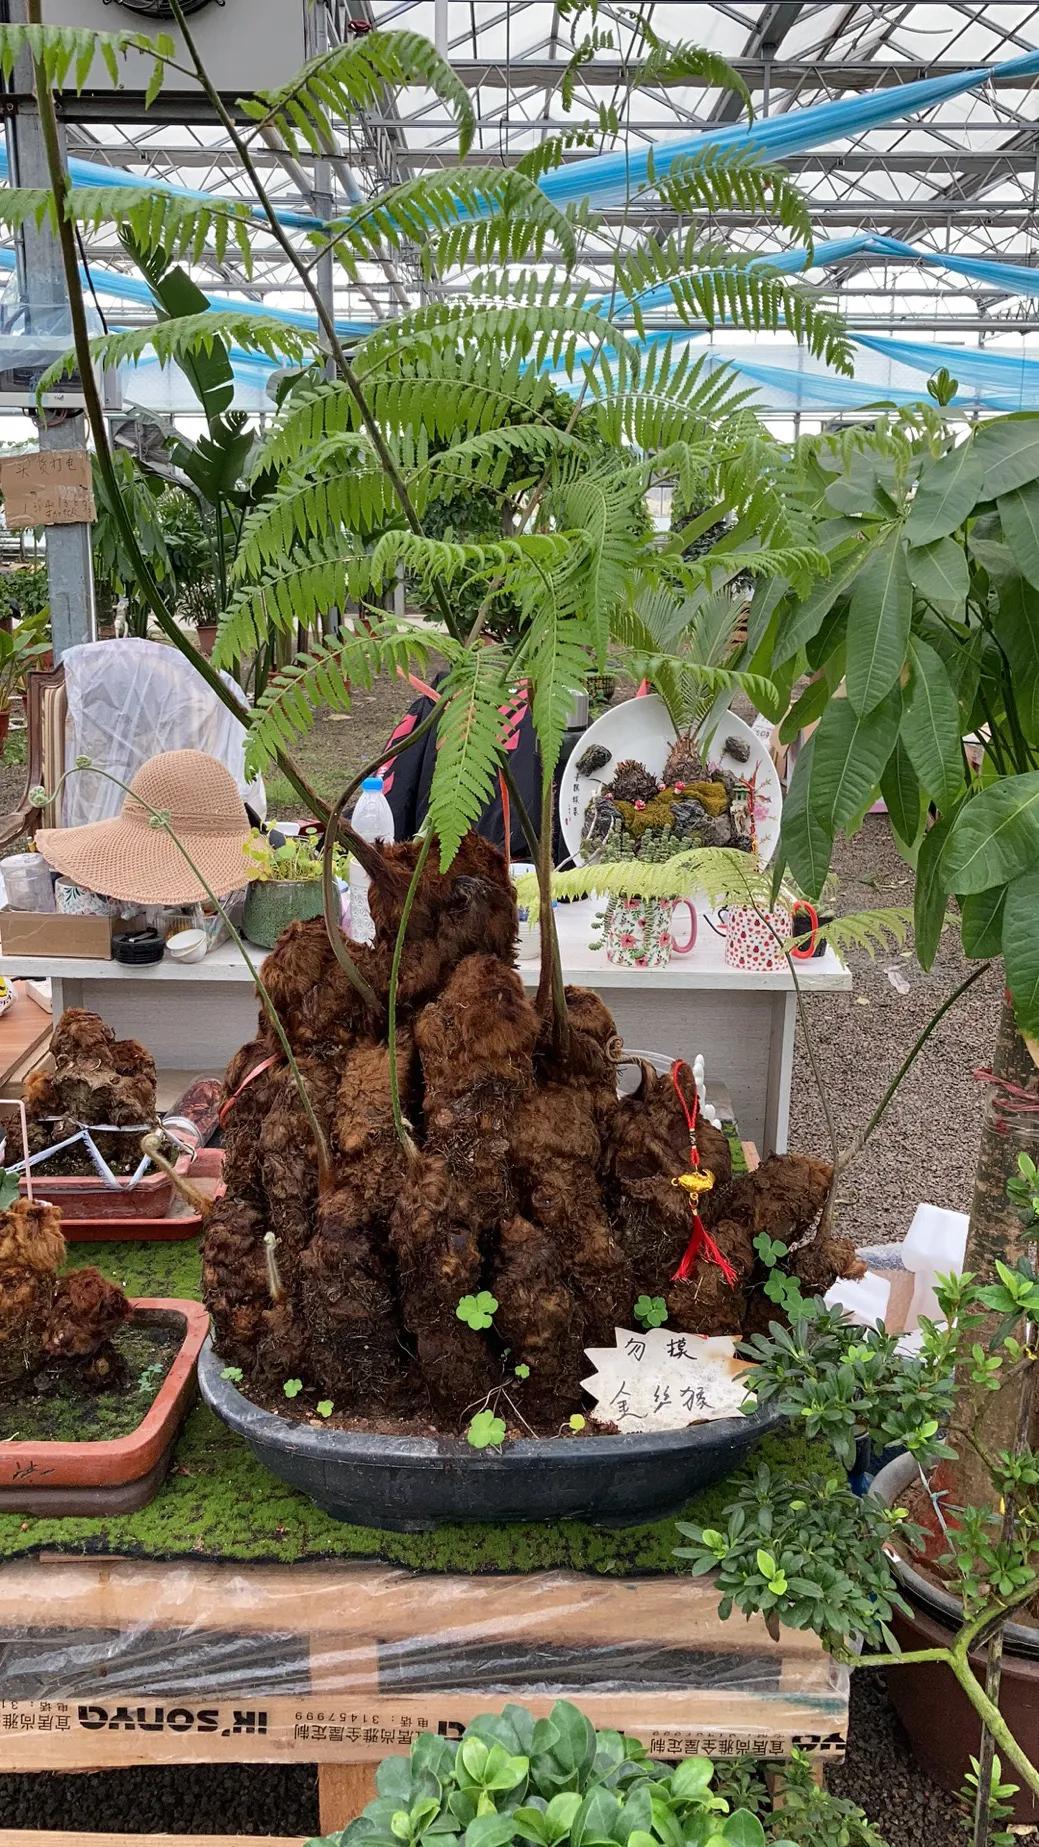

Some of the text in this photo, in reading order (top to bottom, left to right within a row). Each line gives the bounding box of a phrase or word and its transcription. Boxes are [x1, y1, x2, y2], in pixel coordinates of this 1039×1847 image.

[624, 1337, 698, 1362] 勿摸
[1, 1713, 71, 1732] 宜居尚雅
[650, 1738, 786, 1756] 宜居尚雅全屋定制
